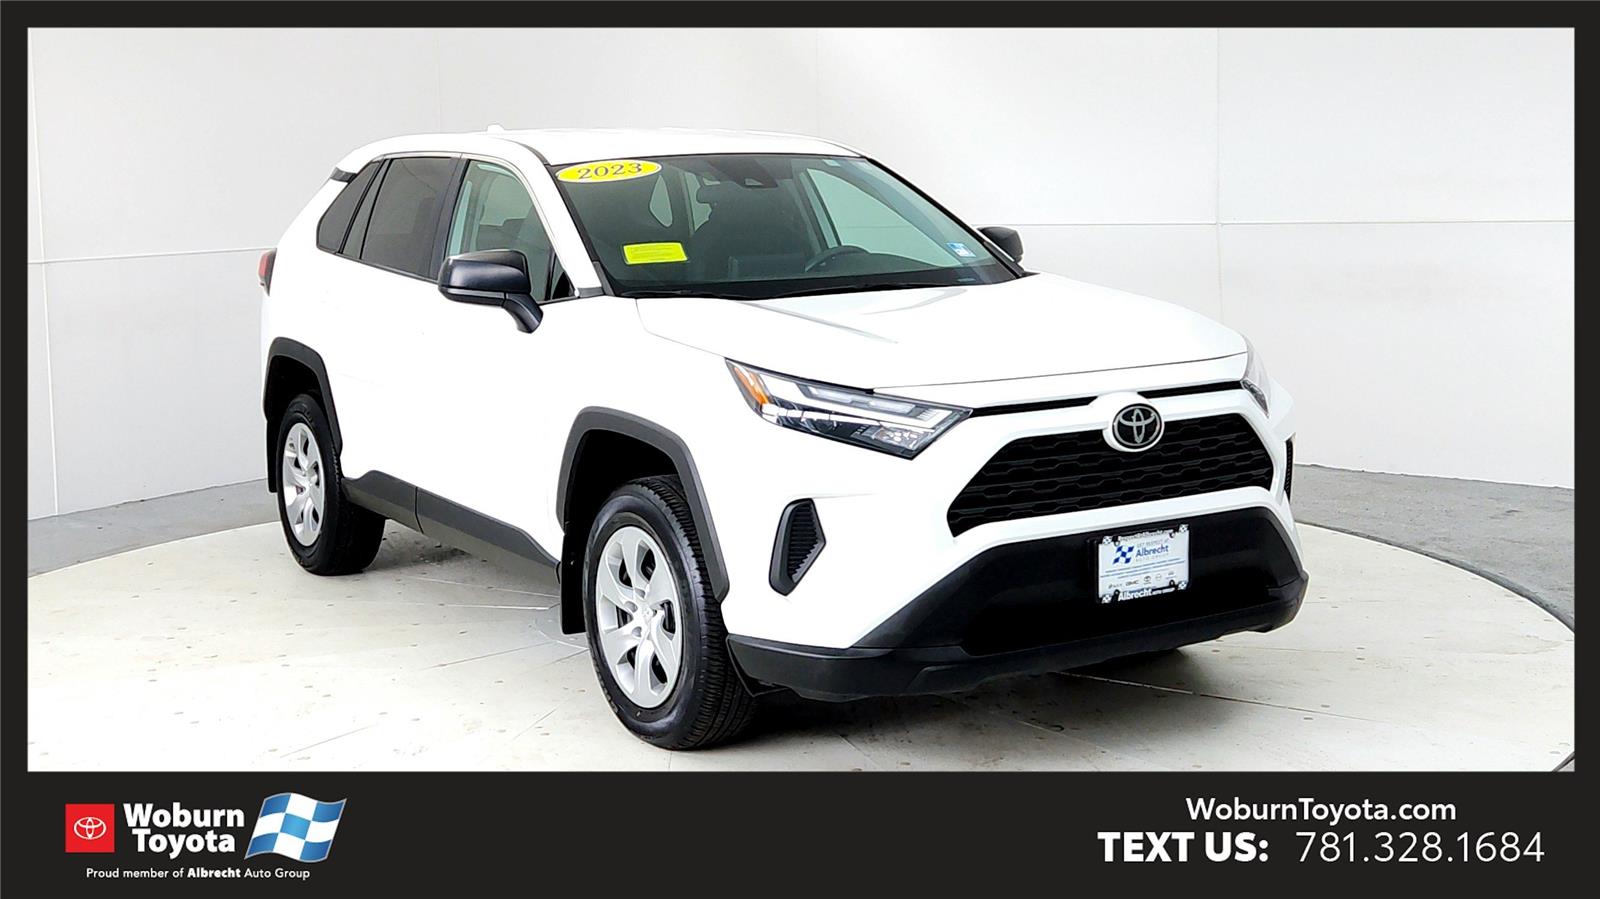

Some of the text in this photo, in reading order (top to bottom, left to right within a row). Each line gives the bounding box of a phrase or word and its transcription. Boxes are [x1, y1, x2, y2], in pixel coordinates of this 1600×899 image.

[577, 162, 643, 180] 2023
[1135, 544, 1169, 558] Albrecht
[1118, 588, 1153, 601] Albrecht
